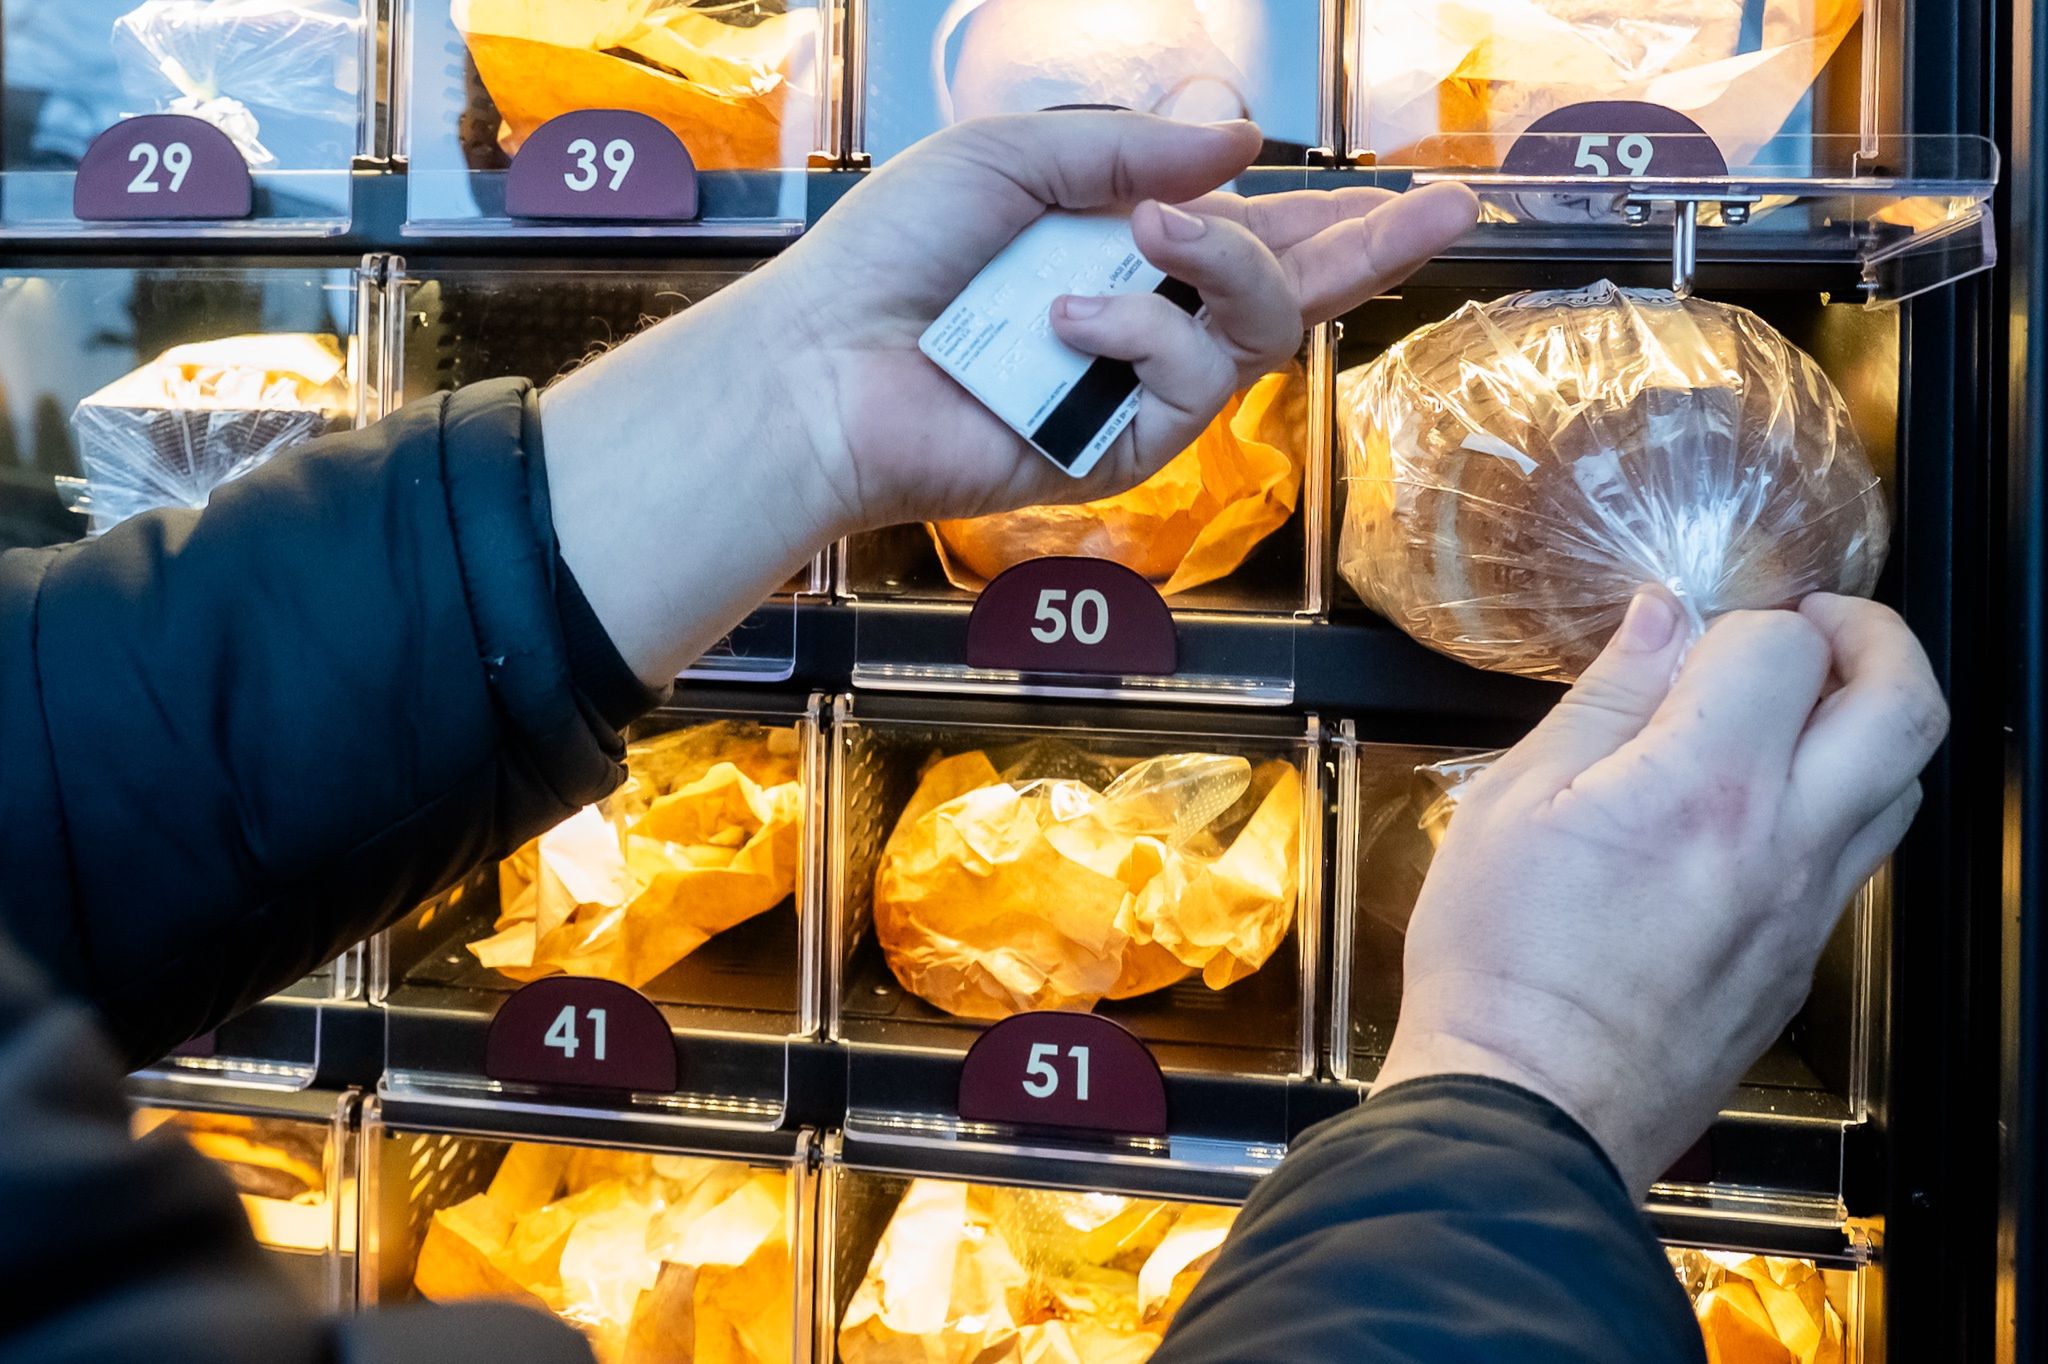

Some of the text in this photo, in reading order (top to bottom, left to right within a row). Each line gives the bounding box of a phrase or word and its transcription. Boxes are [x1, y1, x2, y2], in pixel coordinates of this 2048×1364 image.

[128, 143, 192, 192] 29
[565, 139, 634, 191] 39
[1574, 134, 1654, 176] 59
[1031, 589, 1108, 644] 50
[544, 1006, 606, 1060] 41
[1023, 1043, 1088, 1100] 51
